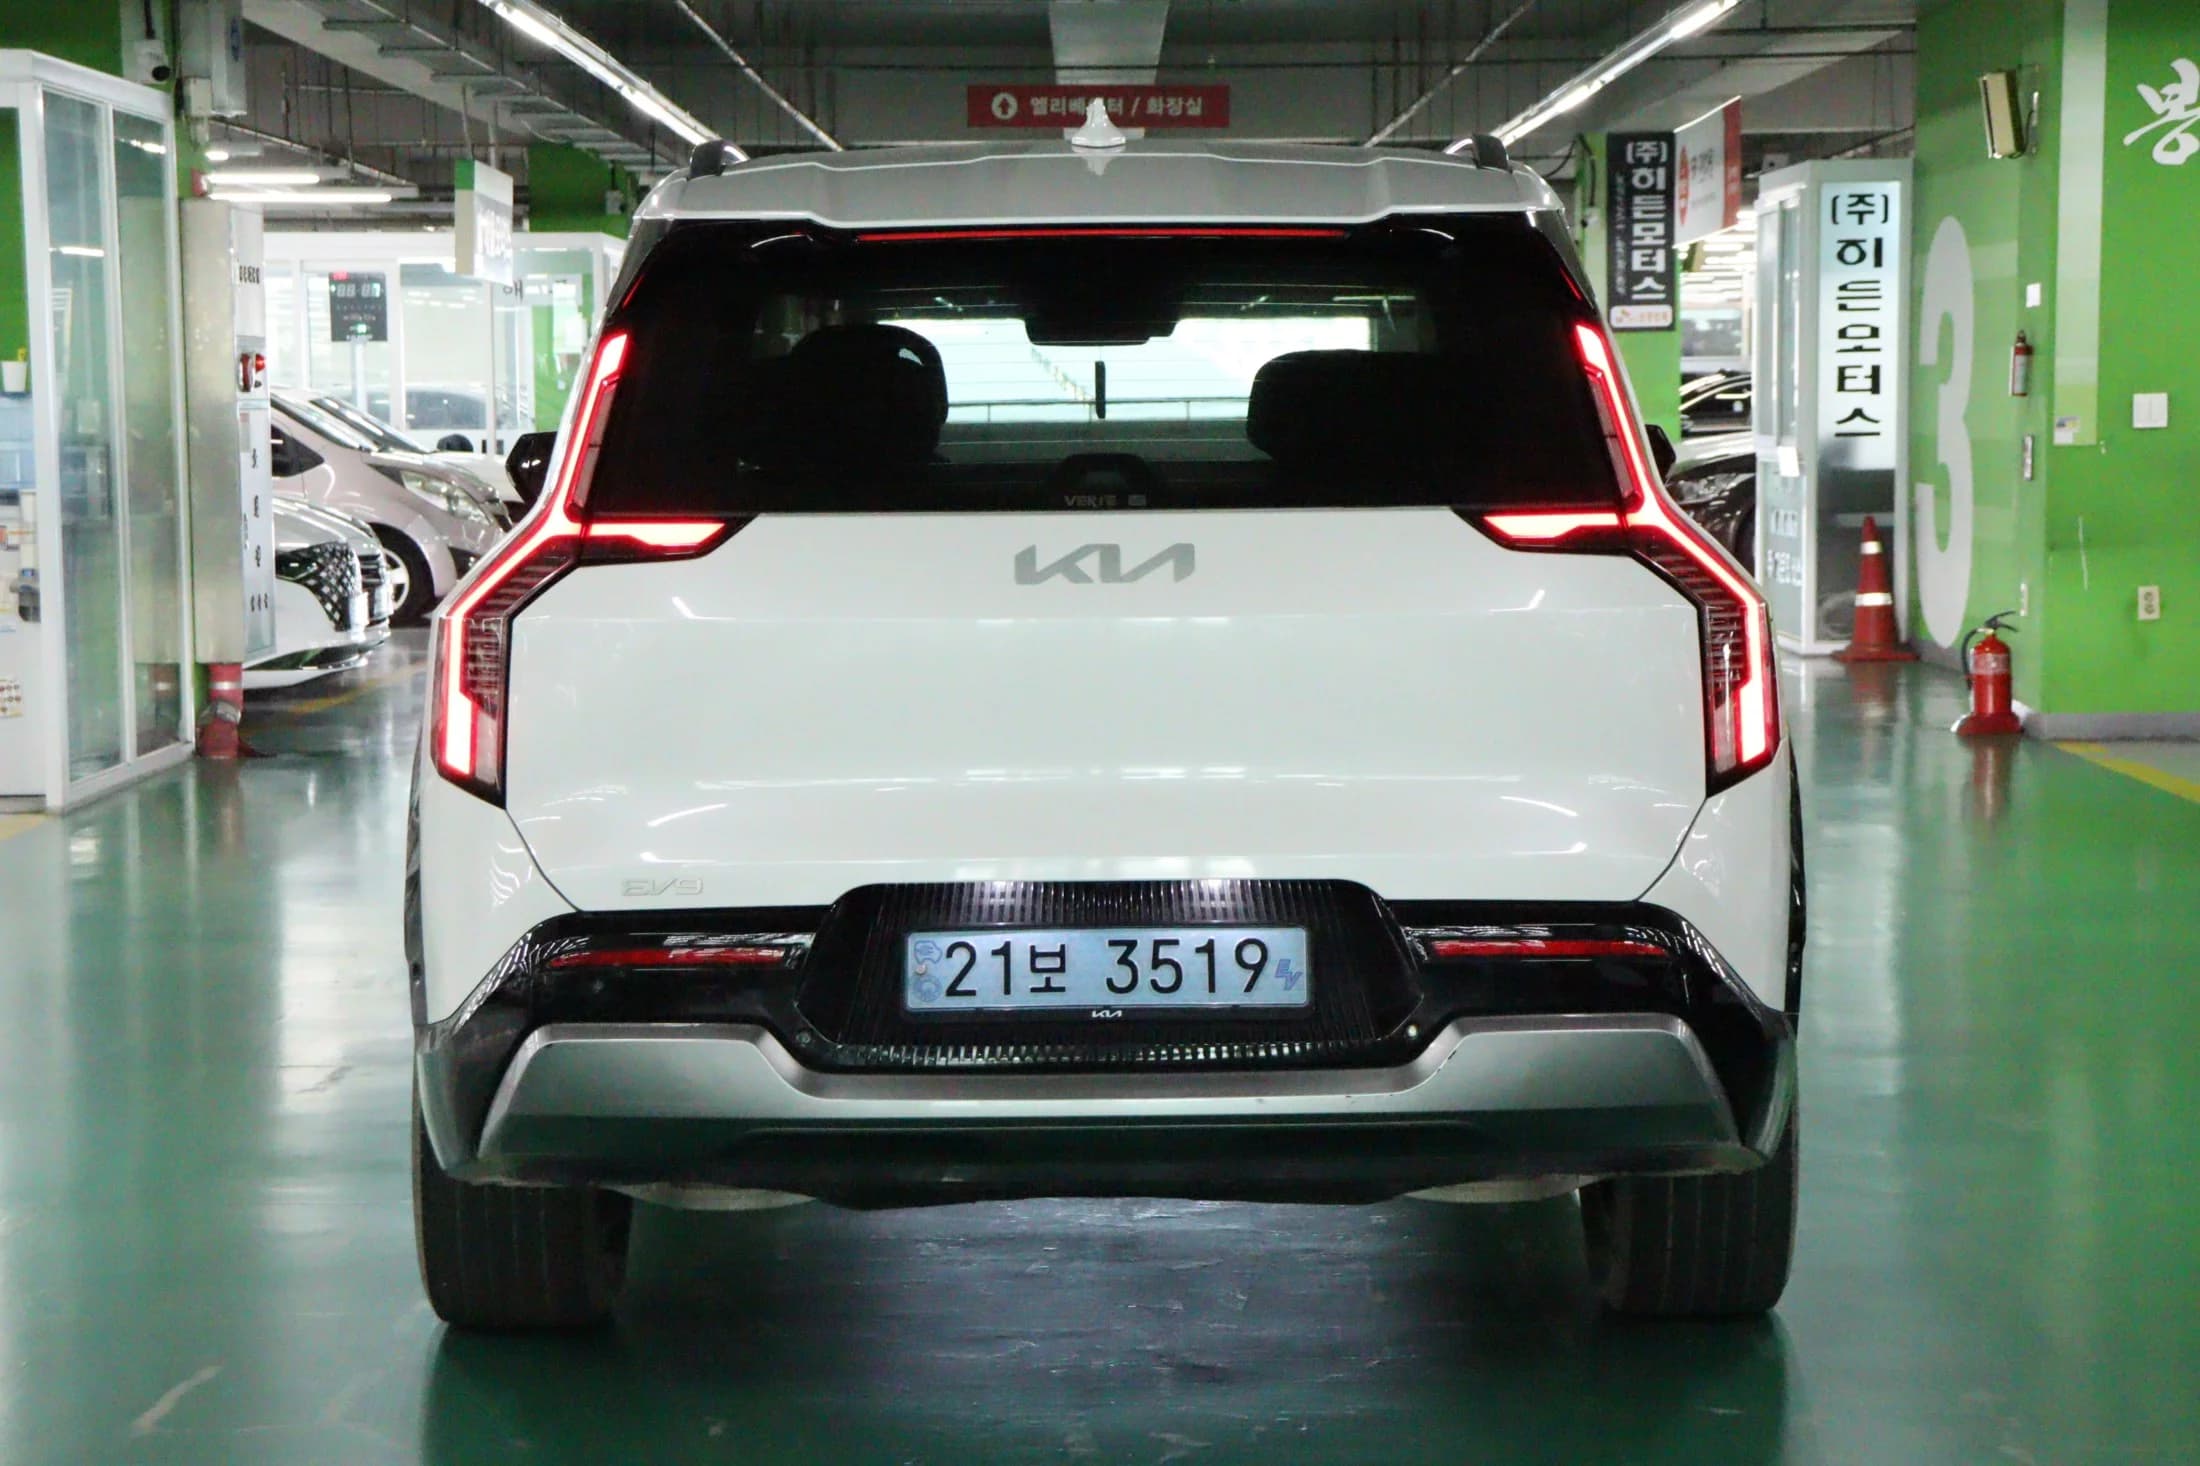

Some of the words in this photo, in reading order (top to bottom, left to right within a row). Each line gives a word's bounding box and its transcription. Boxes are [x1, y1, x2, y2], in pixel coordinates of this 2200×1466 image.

[1030, 96, 1123, 116] 엘리베터
[1147, 96, 1203, 116] 화장실
[1915, 215, 1974, 649] 3
[1014, 543, 1195, 585] KIA
[621, 878, 703, 896] EV9
[944, 940, 1067, 997] 21보
[1105, 938, 1269, 994] 3519
[1092, 1009, 1122, 1018] KIA
